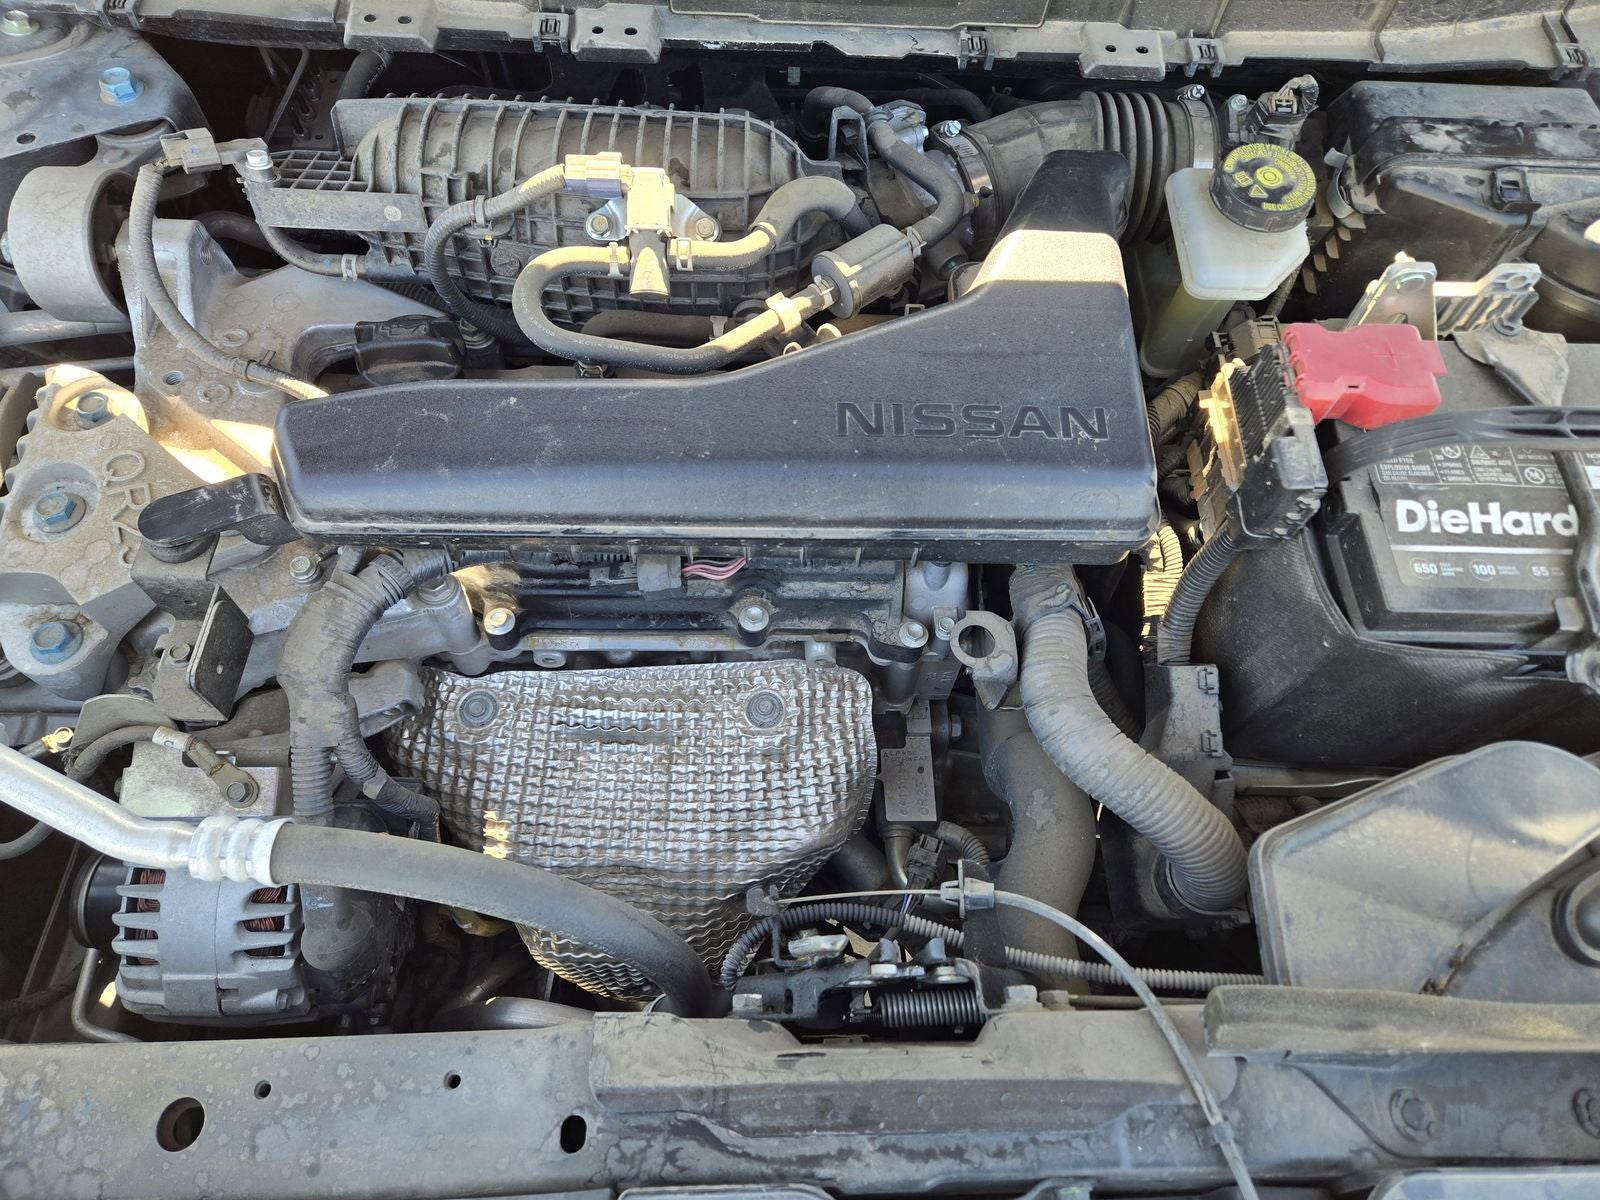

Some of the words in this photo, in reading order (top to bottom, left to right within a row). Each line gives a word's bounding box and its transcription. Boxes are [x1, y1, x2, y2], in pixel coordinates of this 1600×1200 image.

[836, 401, 1110, 440] NISSAN
[1396, 499, 1579, 536] DieHard
[1413, 562, 1438, 574] 650
[1472, 564, 1496, 576] 100
[1531, 566, 1549, 577] 55
